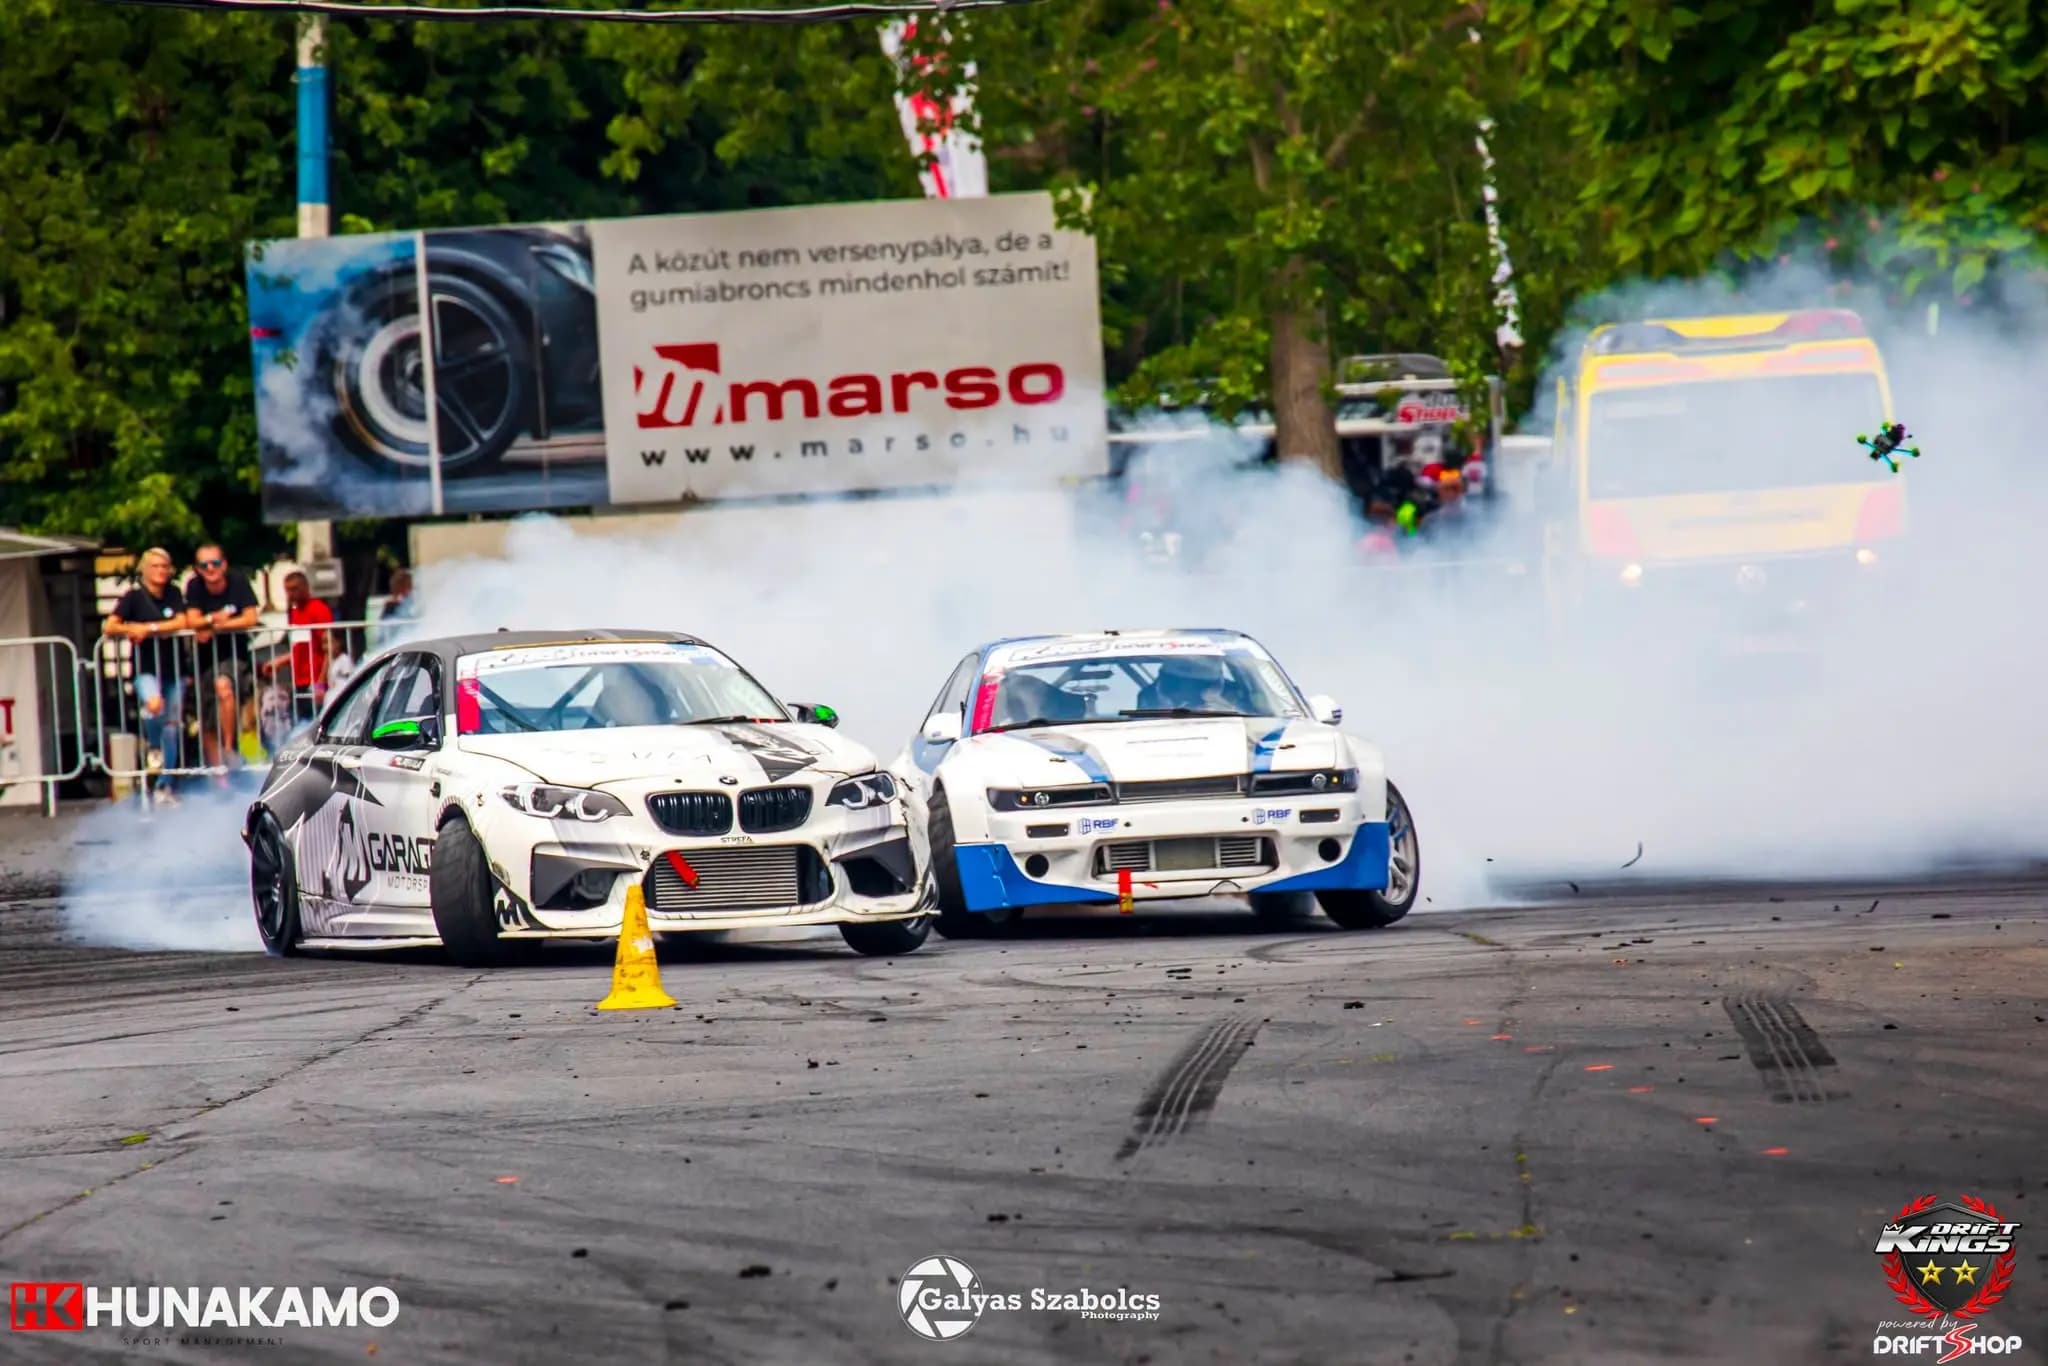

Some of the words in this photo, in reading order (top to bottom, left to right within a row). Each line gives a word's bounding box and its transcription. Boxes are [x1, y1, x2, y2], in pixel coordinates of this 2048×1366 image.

[628, 252, 649, 276] A
[738, 247, 801, 269] nem
[807, 234, 990, 264] versenypálya,
[995, 230, 1030, 252] de
[1037, 232, 1054, 250] a
[630, 278, 812, 313] gumiabroncs
[818, 265, 966, 296] mindenhol
[730, 363, 1066, 423] marso
[1093, 818, 1119, 829] RBF
[1267, 809, 1292, 819] RBF
[367, 832, 437, 875] GARAG
